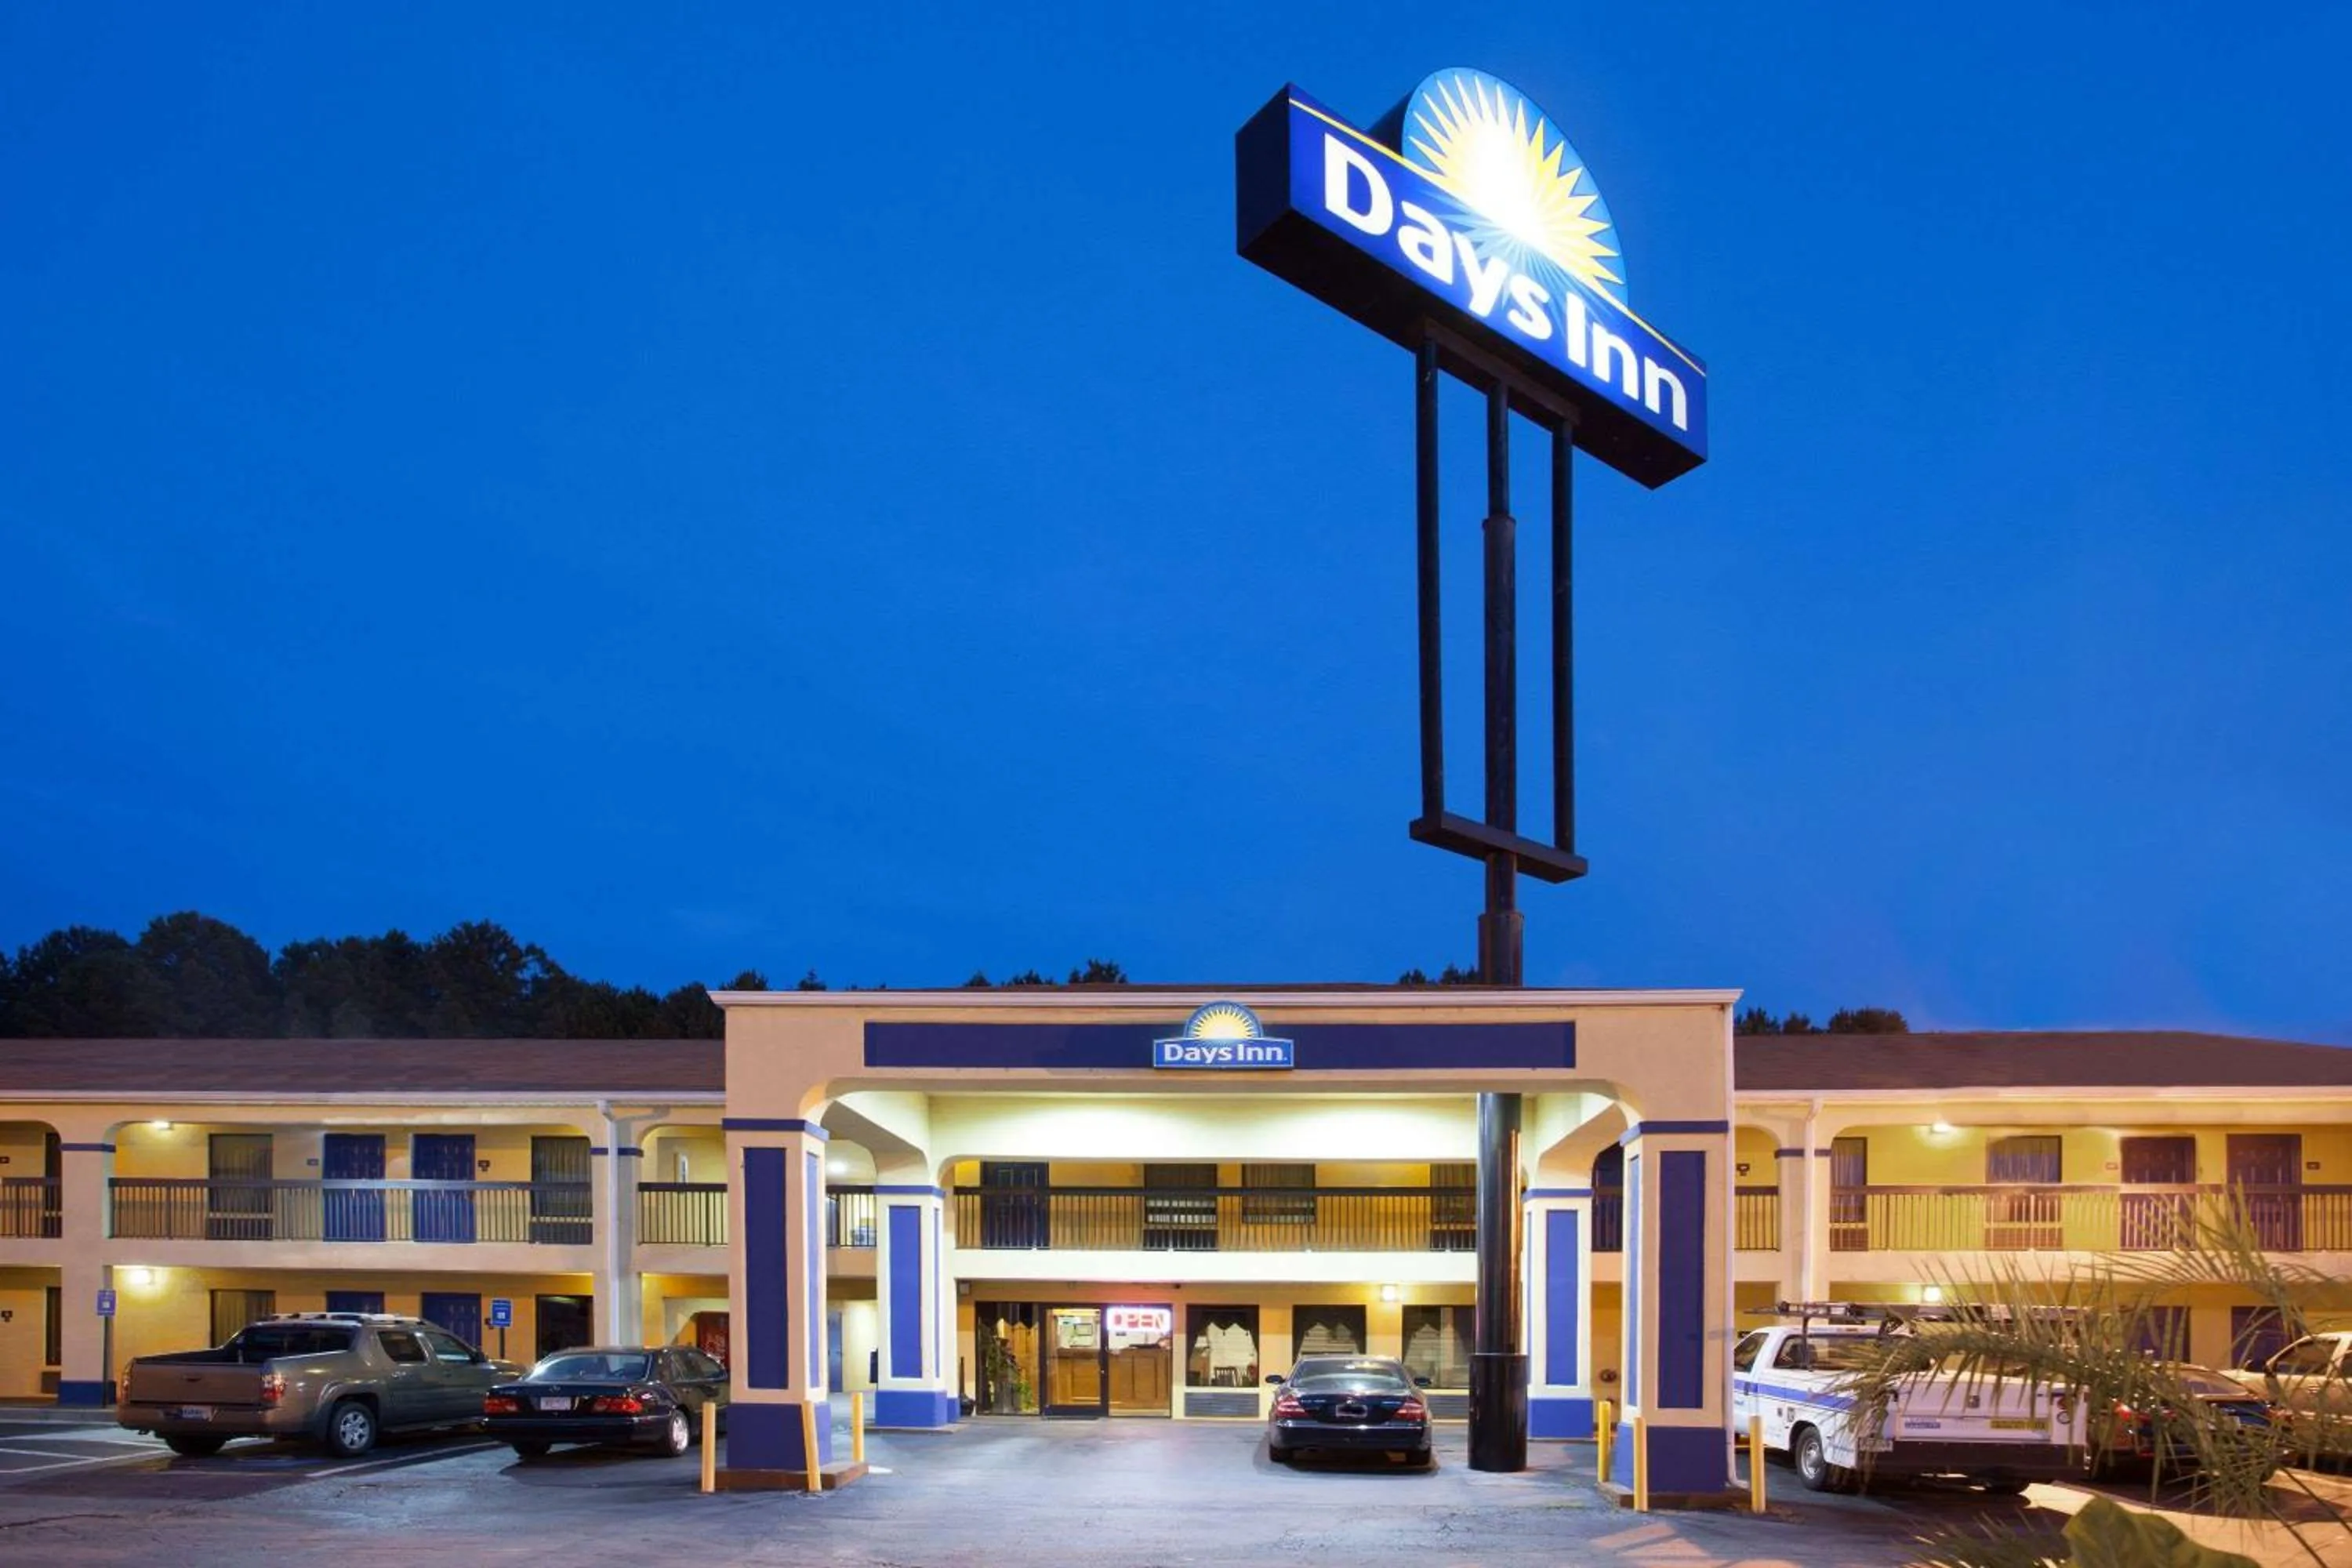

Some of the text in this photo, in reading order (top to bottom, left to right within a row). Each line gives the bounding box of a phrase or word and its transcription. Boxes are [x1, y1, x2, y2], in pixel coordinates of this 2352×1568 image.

[1324, 133, 1688, 431] Days Inn
[1163, 1044, 1232, 1063] Days
[1111, 1312, 1165, 1330] OPEN
